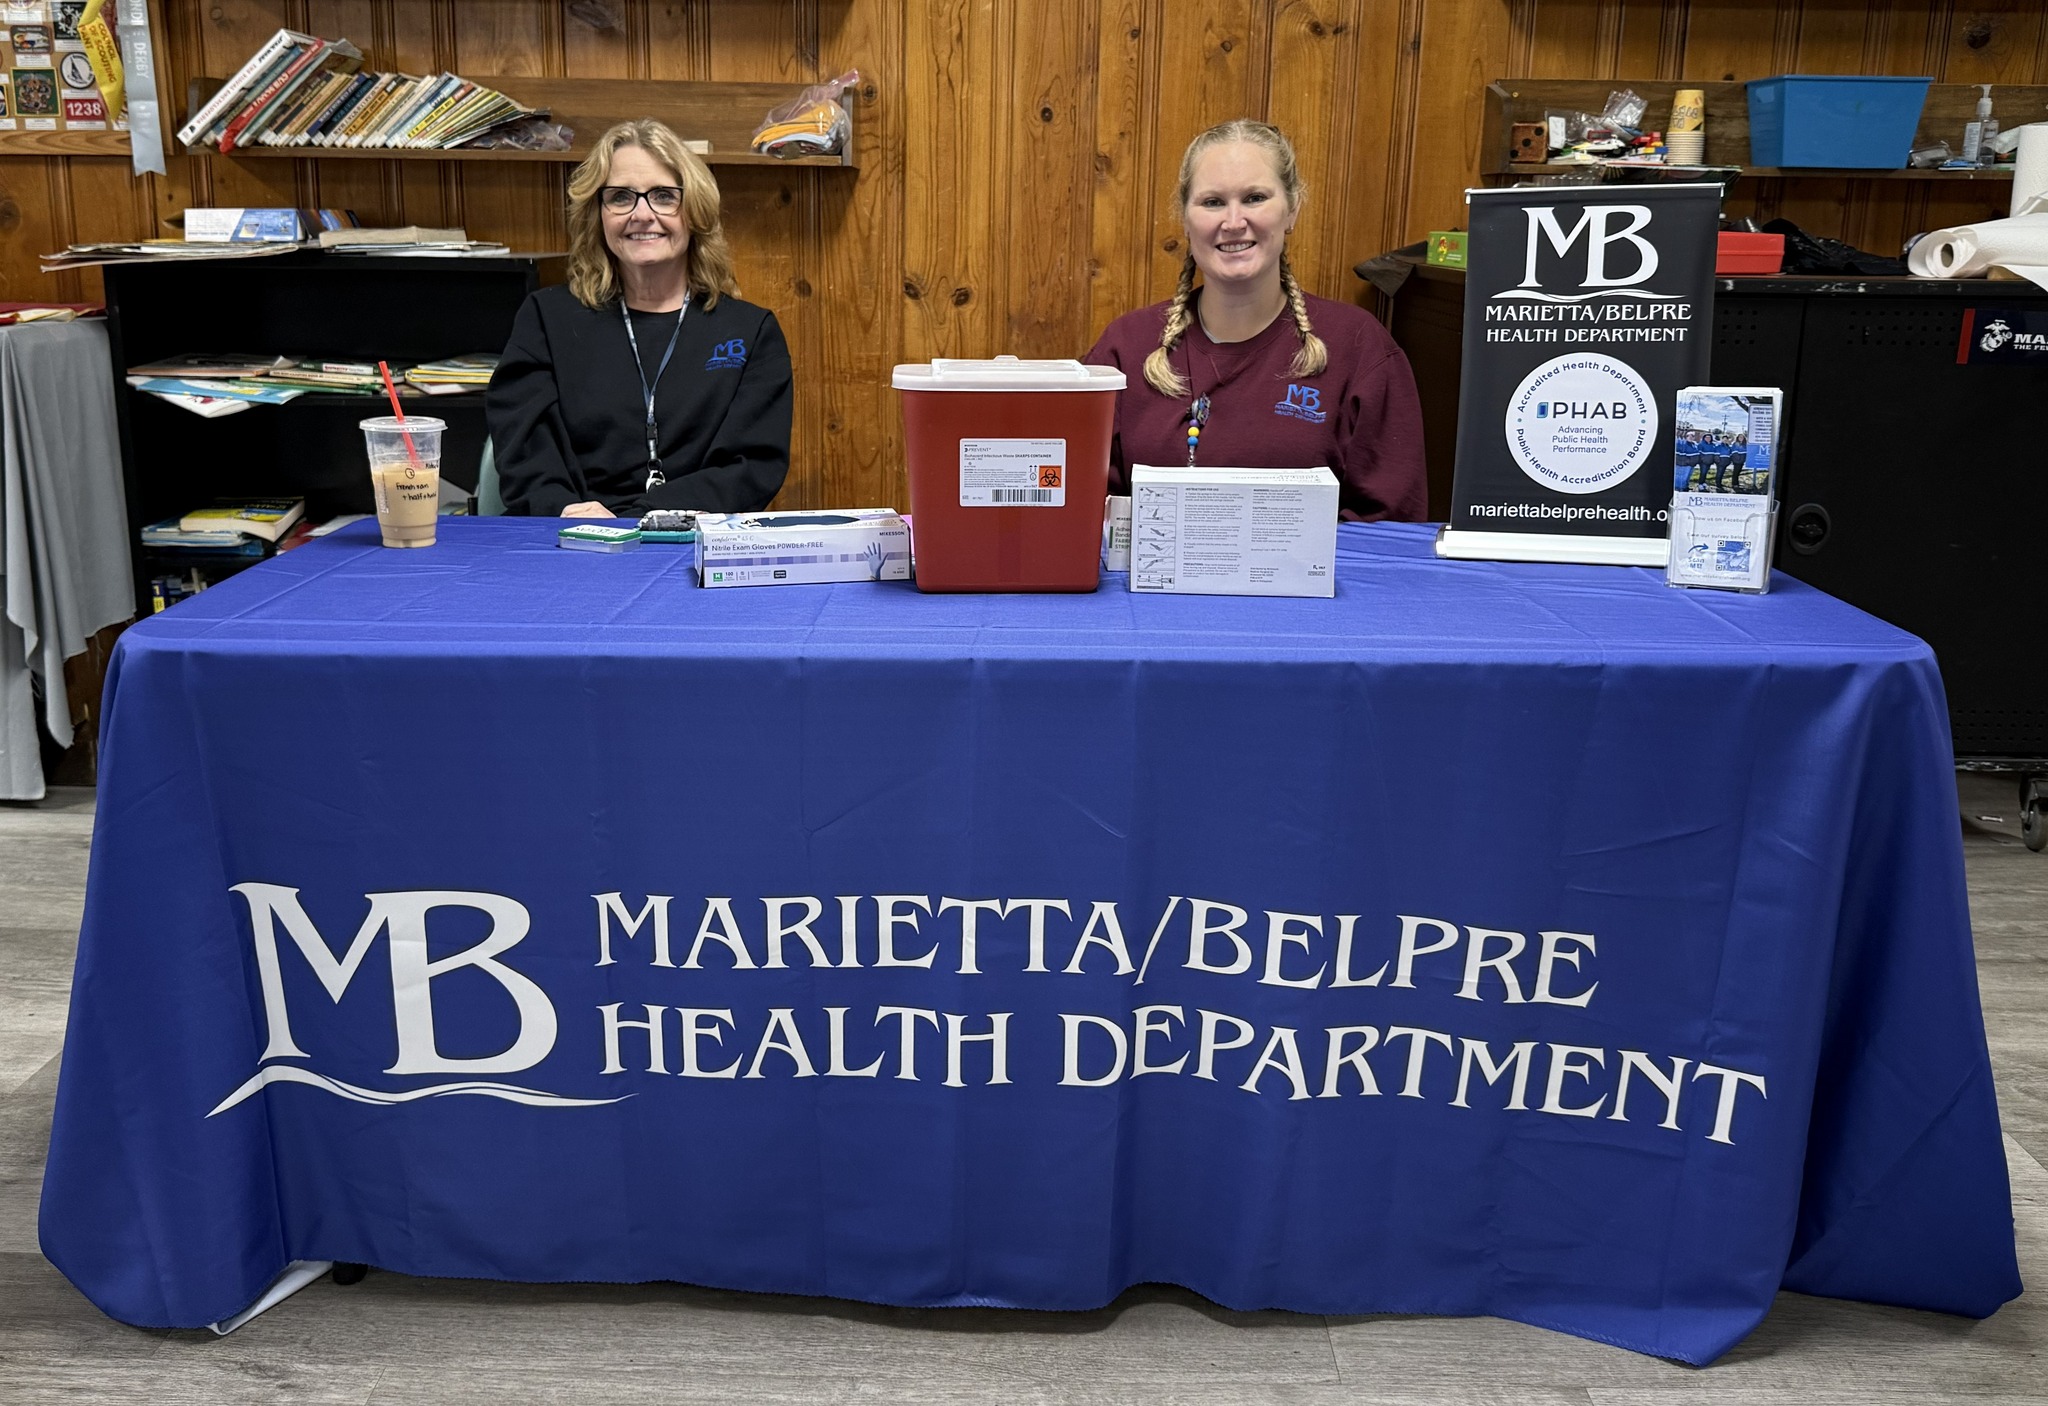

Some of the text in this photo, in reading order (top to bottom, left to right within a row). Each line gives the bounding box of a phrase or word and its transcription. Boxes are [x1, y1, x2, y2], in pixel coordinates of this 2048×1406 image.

[94, 38, 117, 84] SCOUTING
[133, 41, 149, 79] DERBY
[67, 103, 101, 116] 1238
[1517, 205, 1659, 287] MB
[1486, 304, 1692, 323] MARIETTA/BELPRE
[1487, 328, 1688, 342] HEALTH DEPARTMENT
[2014, 333, 2048, 344] MA
[1285, 384, 1321, 411] MB
[1517, 361, 1648, 415] Accredited Health Department
[1553, 402, 1627, 419] PHAB
[1552, 435, 1608, 444] Public Health
[1558, 426, 1603, 435] Advancing
[1516, 428, 1646, 484] Public Health Accreditation Board
[1552, 445, 1607, 454] Performance
[1688, 496, 1703, 506] MB
[1469, 503, 1668, 523] mariettabelprehealth.o
[591, 892, 1598, 1007] MARIETTA/BELPRE
[229, 883, 558, 1078] MB
[596, 1003, 1766, 1146] HEALTH DEPARTMENT
